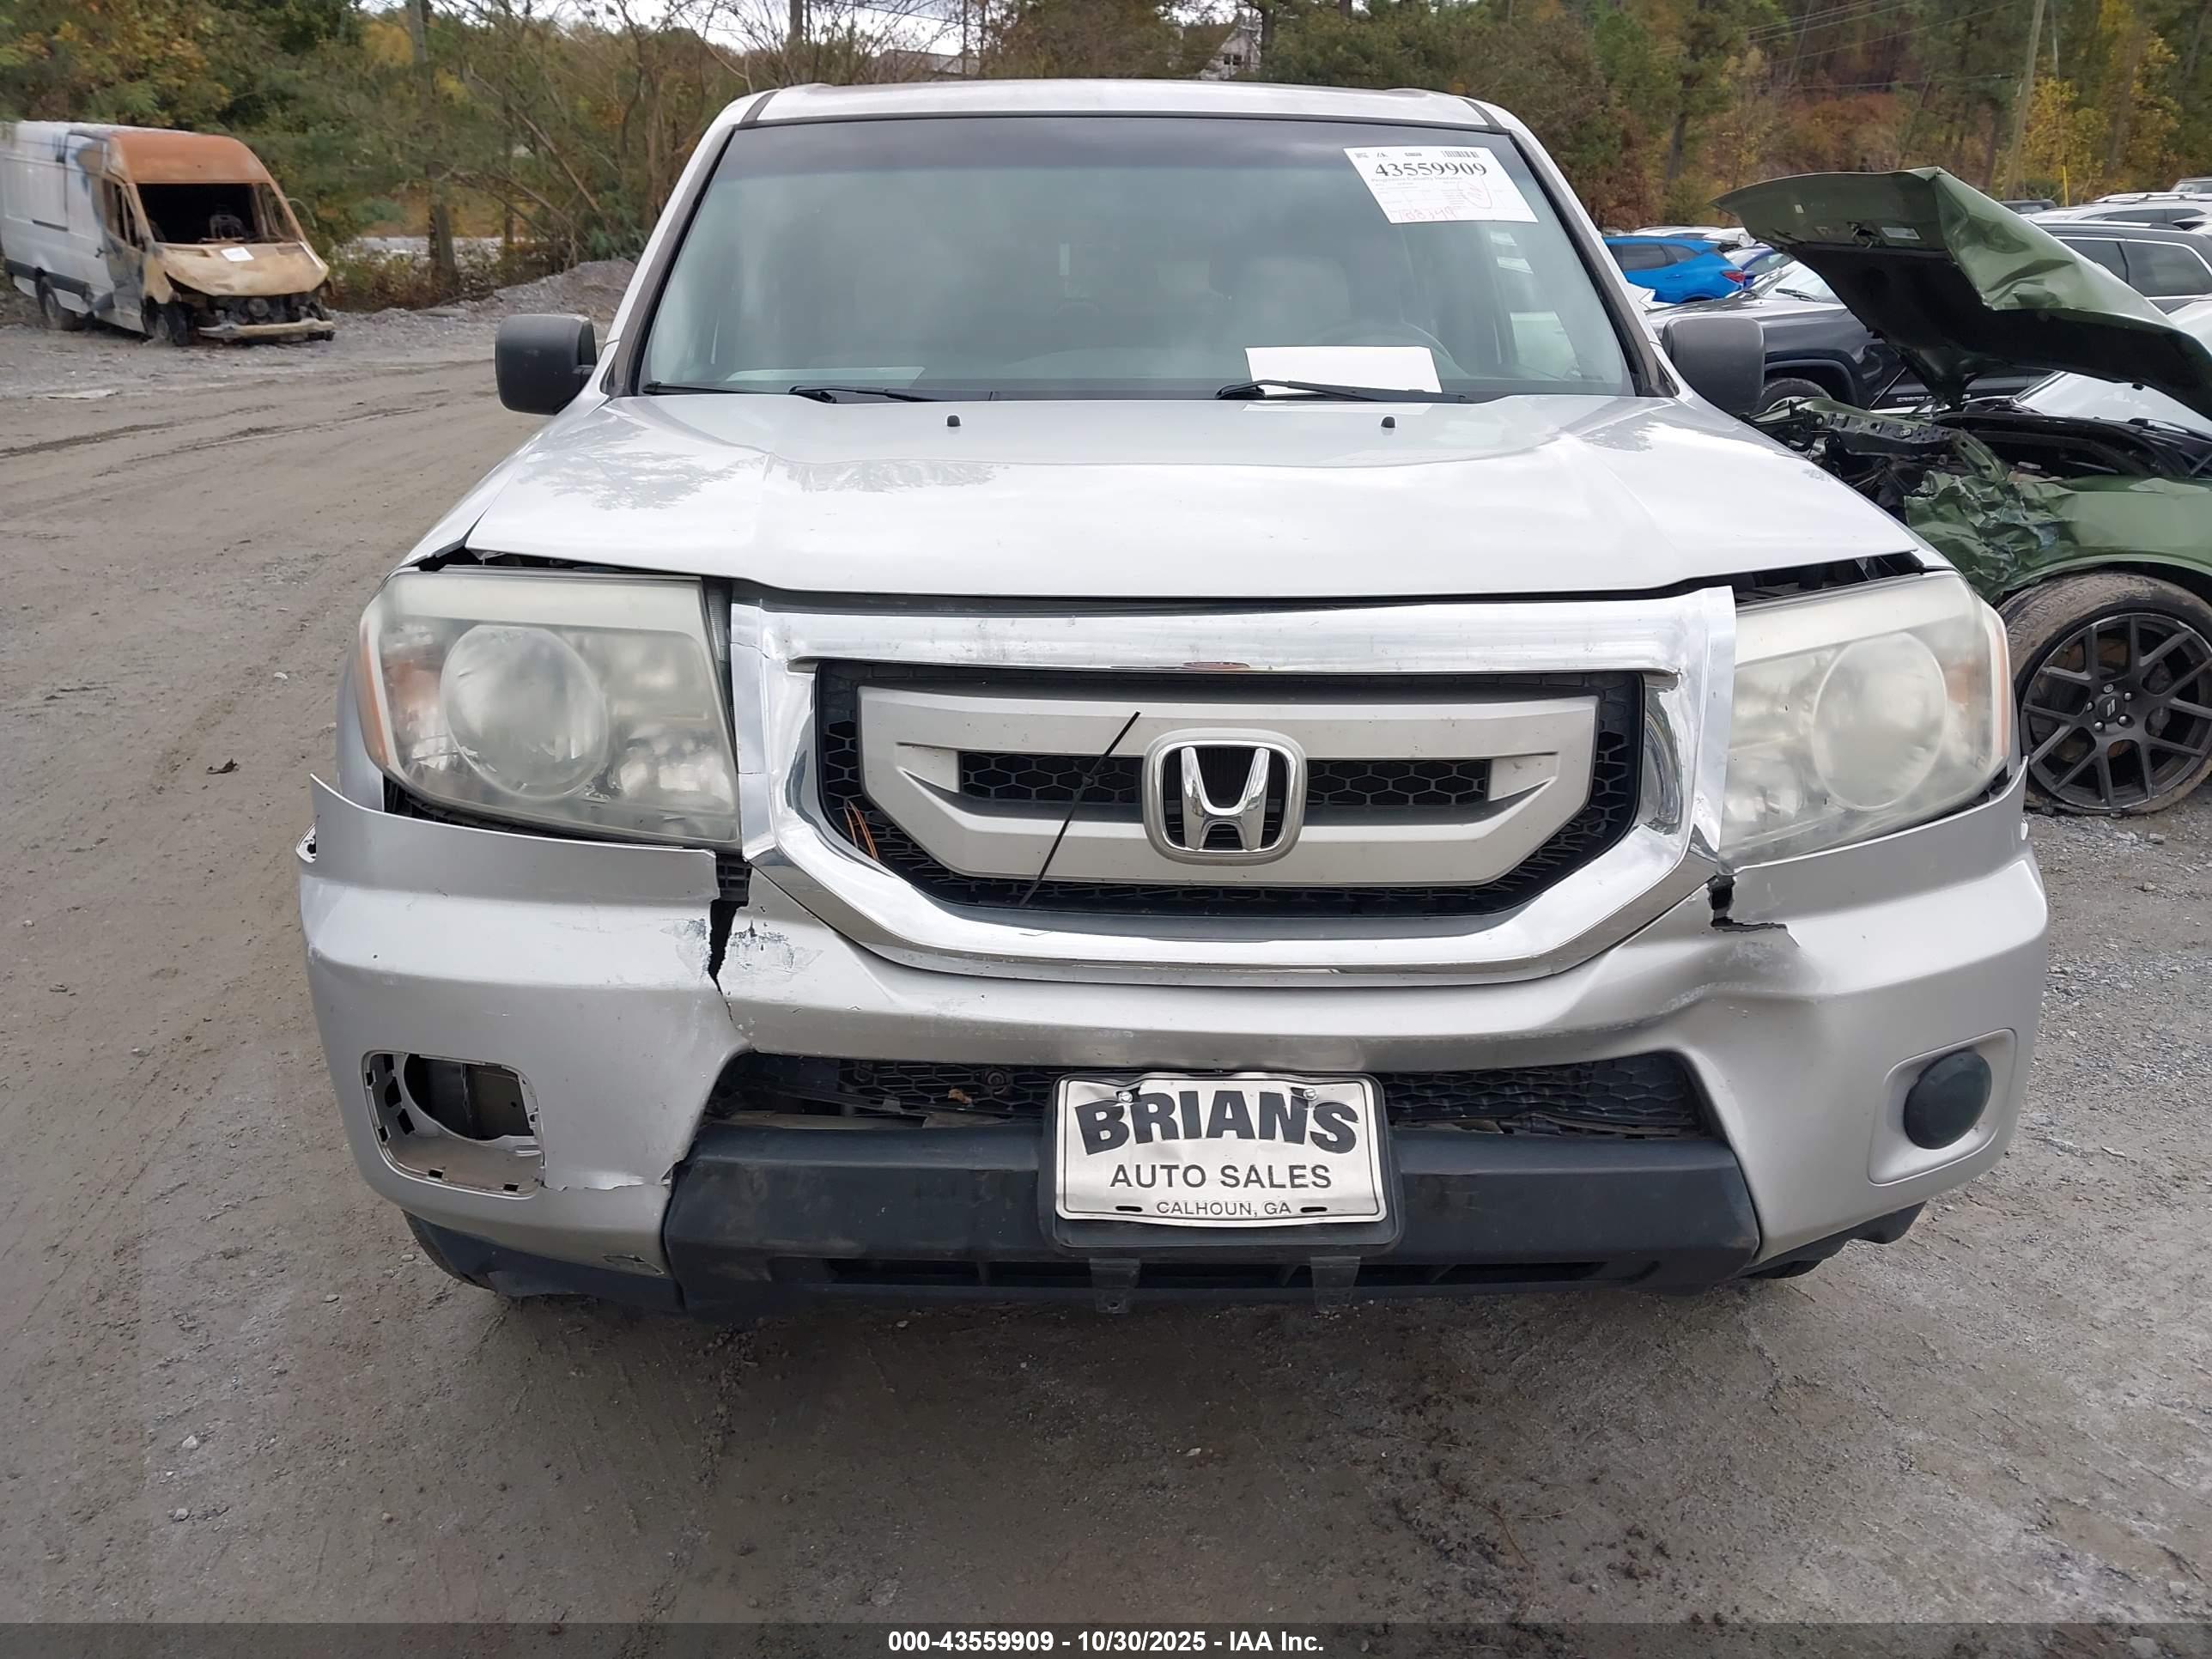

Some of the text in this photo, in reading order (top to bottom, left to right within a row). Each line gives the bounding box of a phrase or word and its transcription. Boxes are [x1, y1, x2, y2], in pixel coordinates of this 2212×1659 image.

[1375, 161, 1487, 177] 43559909
[1075, 1090, 1359, 1155] BRIANS
[1109, 1164, 1332, 1188] AUTO SALES
[1156, 1201, 1292, 1218] CALHOUN, GA
